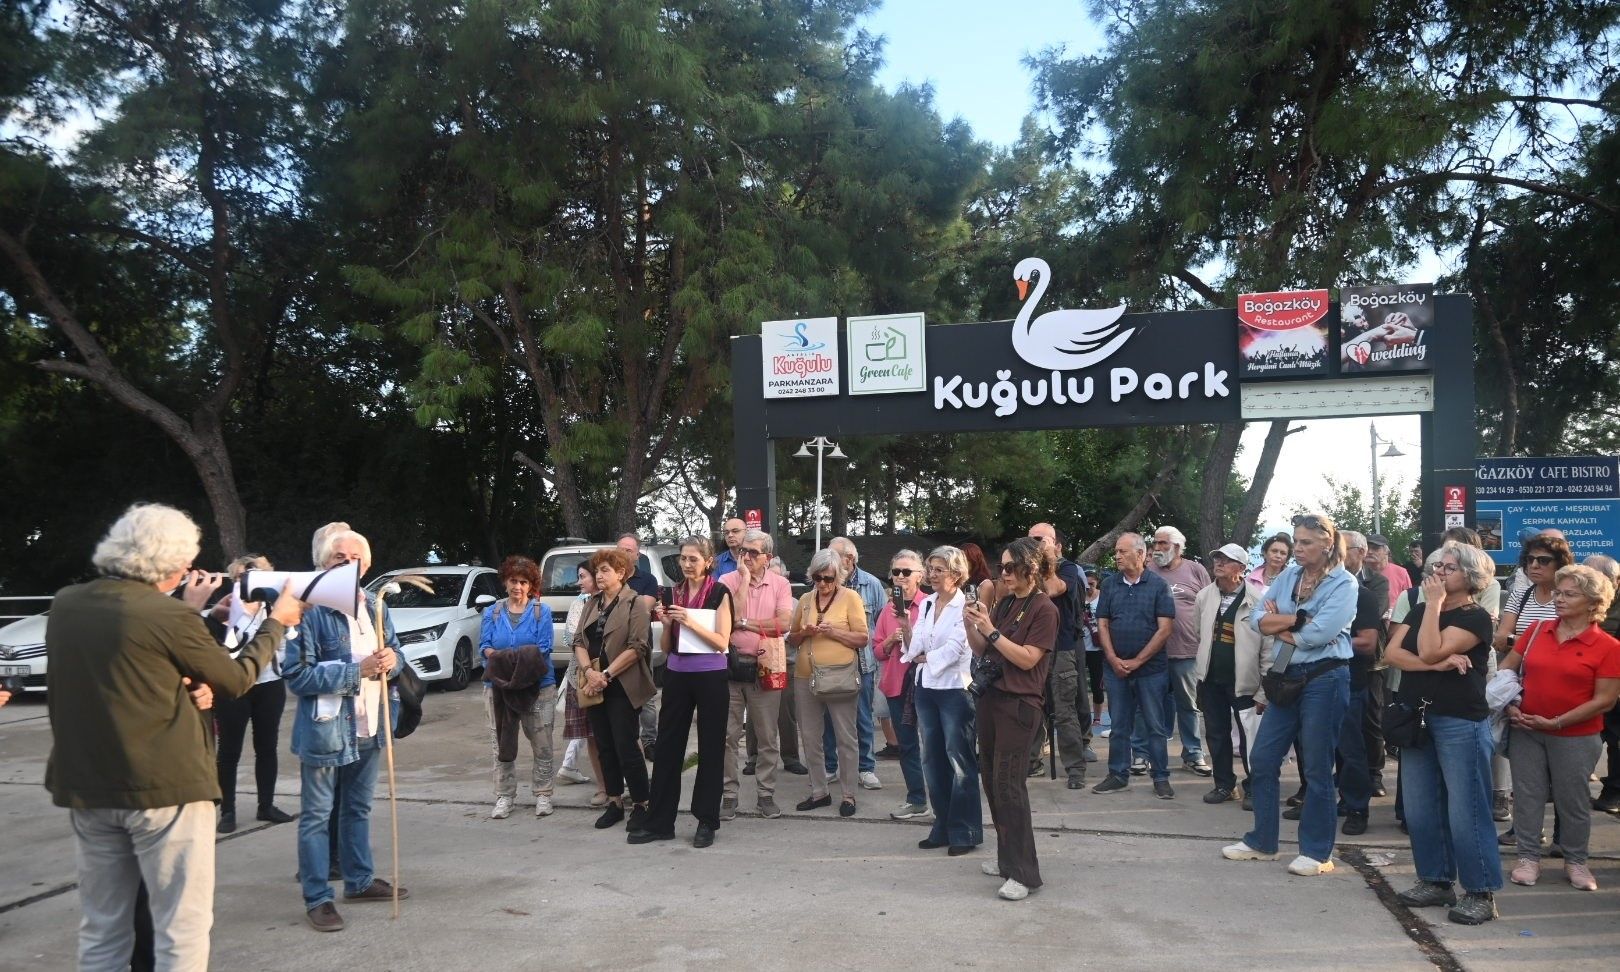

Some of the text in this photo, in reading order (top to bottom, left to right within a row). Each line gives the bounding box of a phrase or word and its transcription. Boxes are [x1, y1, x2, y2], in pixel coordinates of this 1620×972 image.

[1244, 297, 1321, 315] Boğazköy
[1350, 291, 1426, 308] Boğazköy
[1254, 312, 1314, 326] Restaurant
[1371, 343, 1426, 361] wedding
[773, 354, 832, 378] Kuğulu
[860, 364, 913, 383] Green Cafe
[768, 378, 833, 388] PARKMANZARA
[934, 361, 1230, 417] Kuğulu Park
[1475, 464, 1611, 480] ĞAZKÖY CAFE BISTRO
[1486, 486, 1497, 494] 234
[1518, 486, 1533, 494] 0530
[1534, 485, 1545, 493] 221
[1546, 485, 1554, 493] 37
[1568, 485, 1583, 493] 0242
[1584, 485, 1595, 493] 243
[1507, 506, 1524, 515] ÇAY
[1565, 504, 1611, 513] MEŞRUBAT
[1576, 539, 1614, 548] ÇEŞİTLERİ
